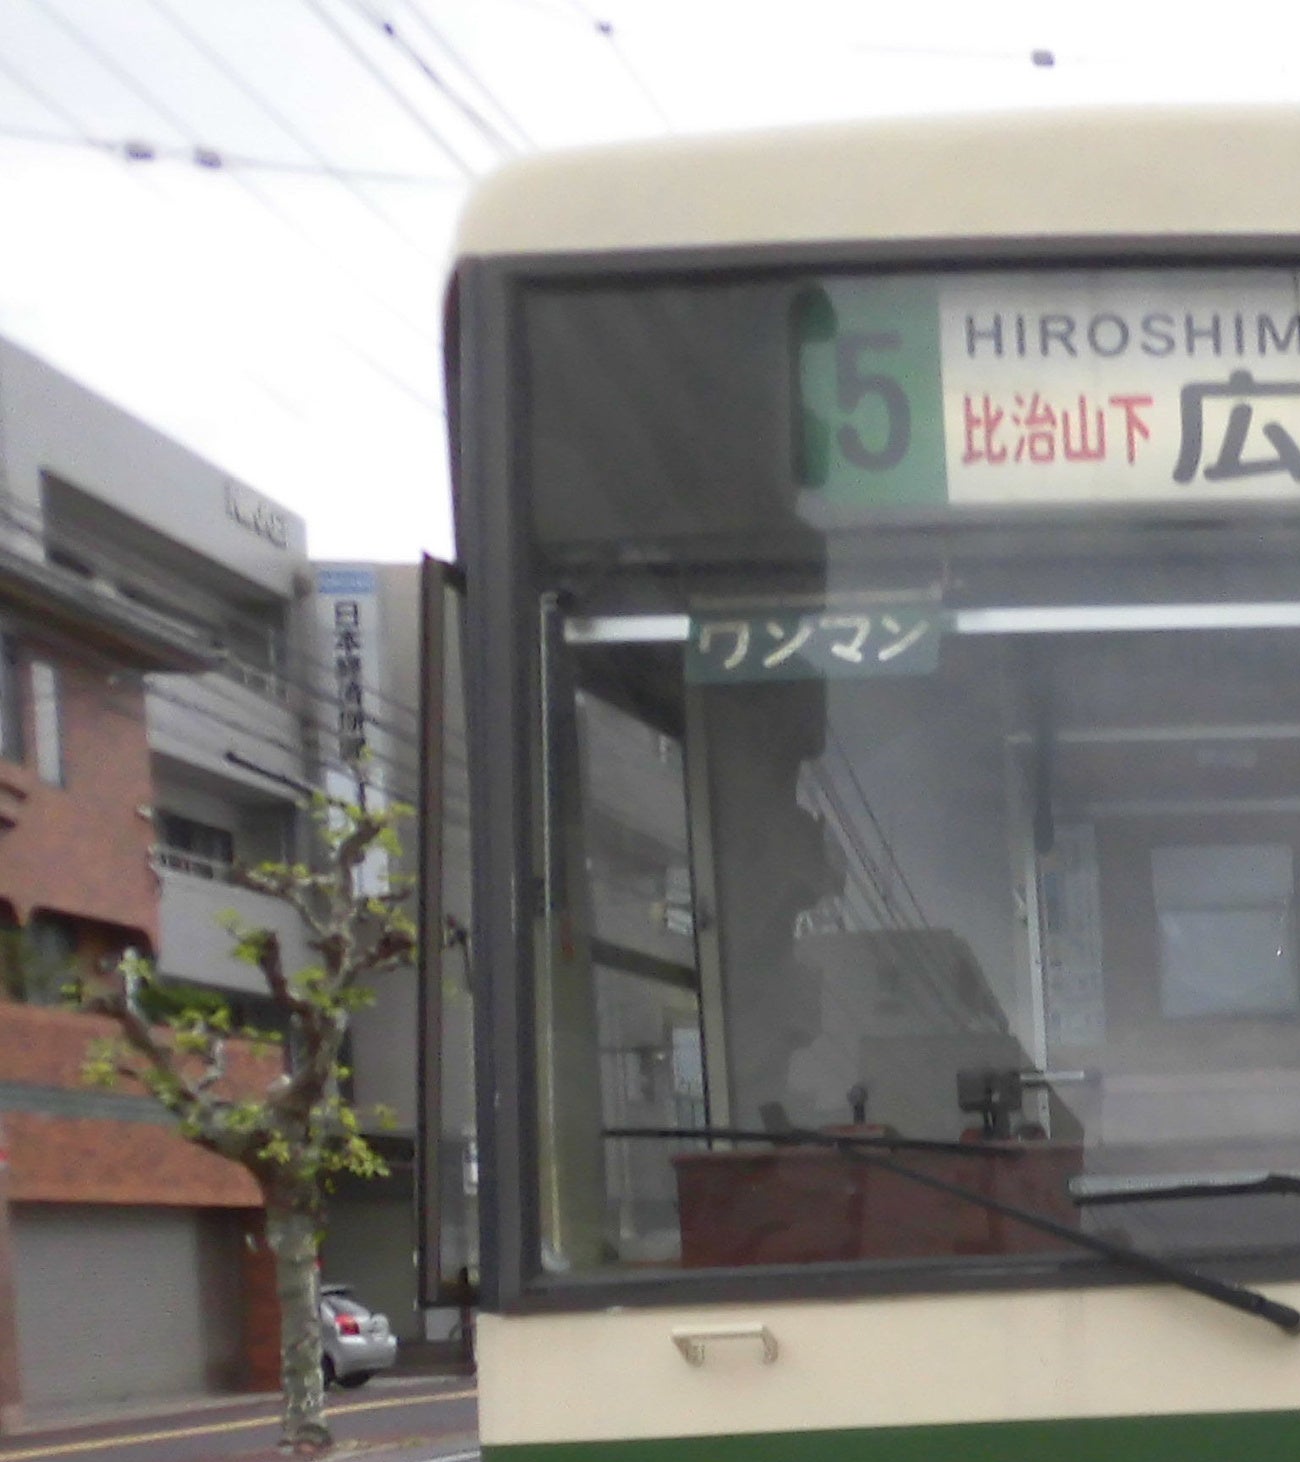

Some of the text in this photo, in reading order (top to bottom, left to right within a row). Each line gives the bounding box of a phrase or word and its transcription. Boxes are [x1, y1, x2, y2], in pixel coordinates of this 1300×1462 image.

[834, 330, 912, 472] 5
[962, 391, 1155, 466] 比治山下
[699, 613, 931, 670] ワンマン
